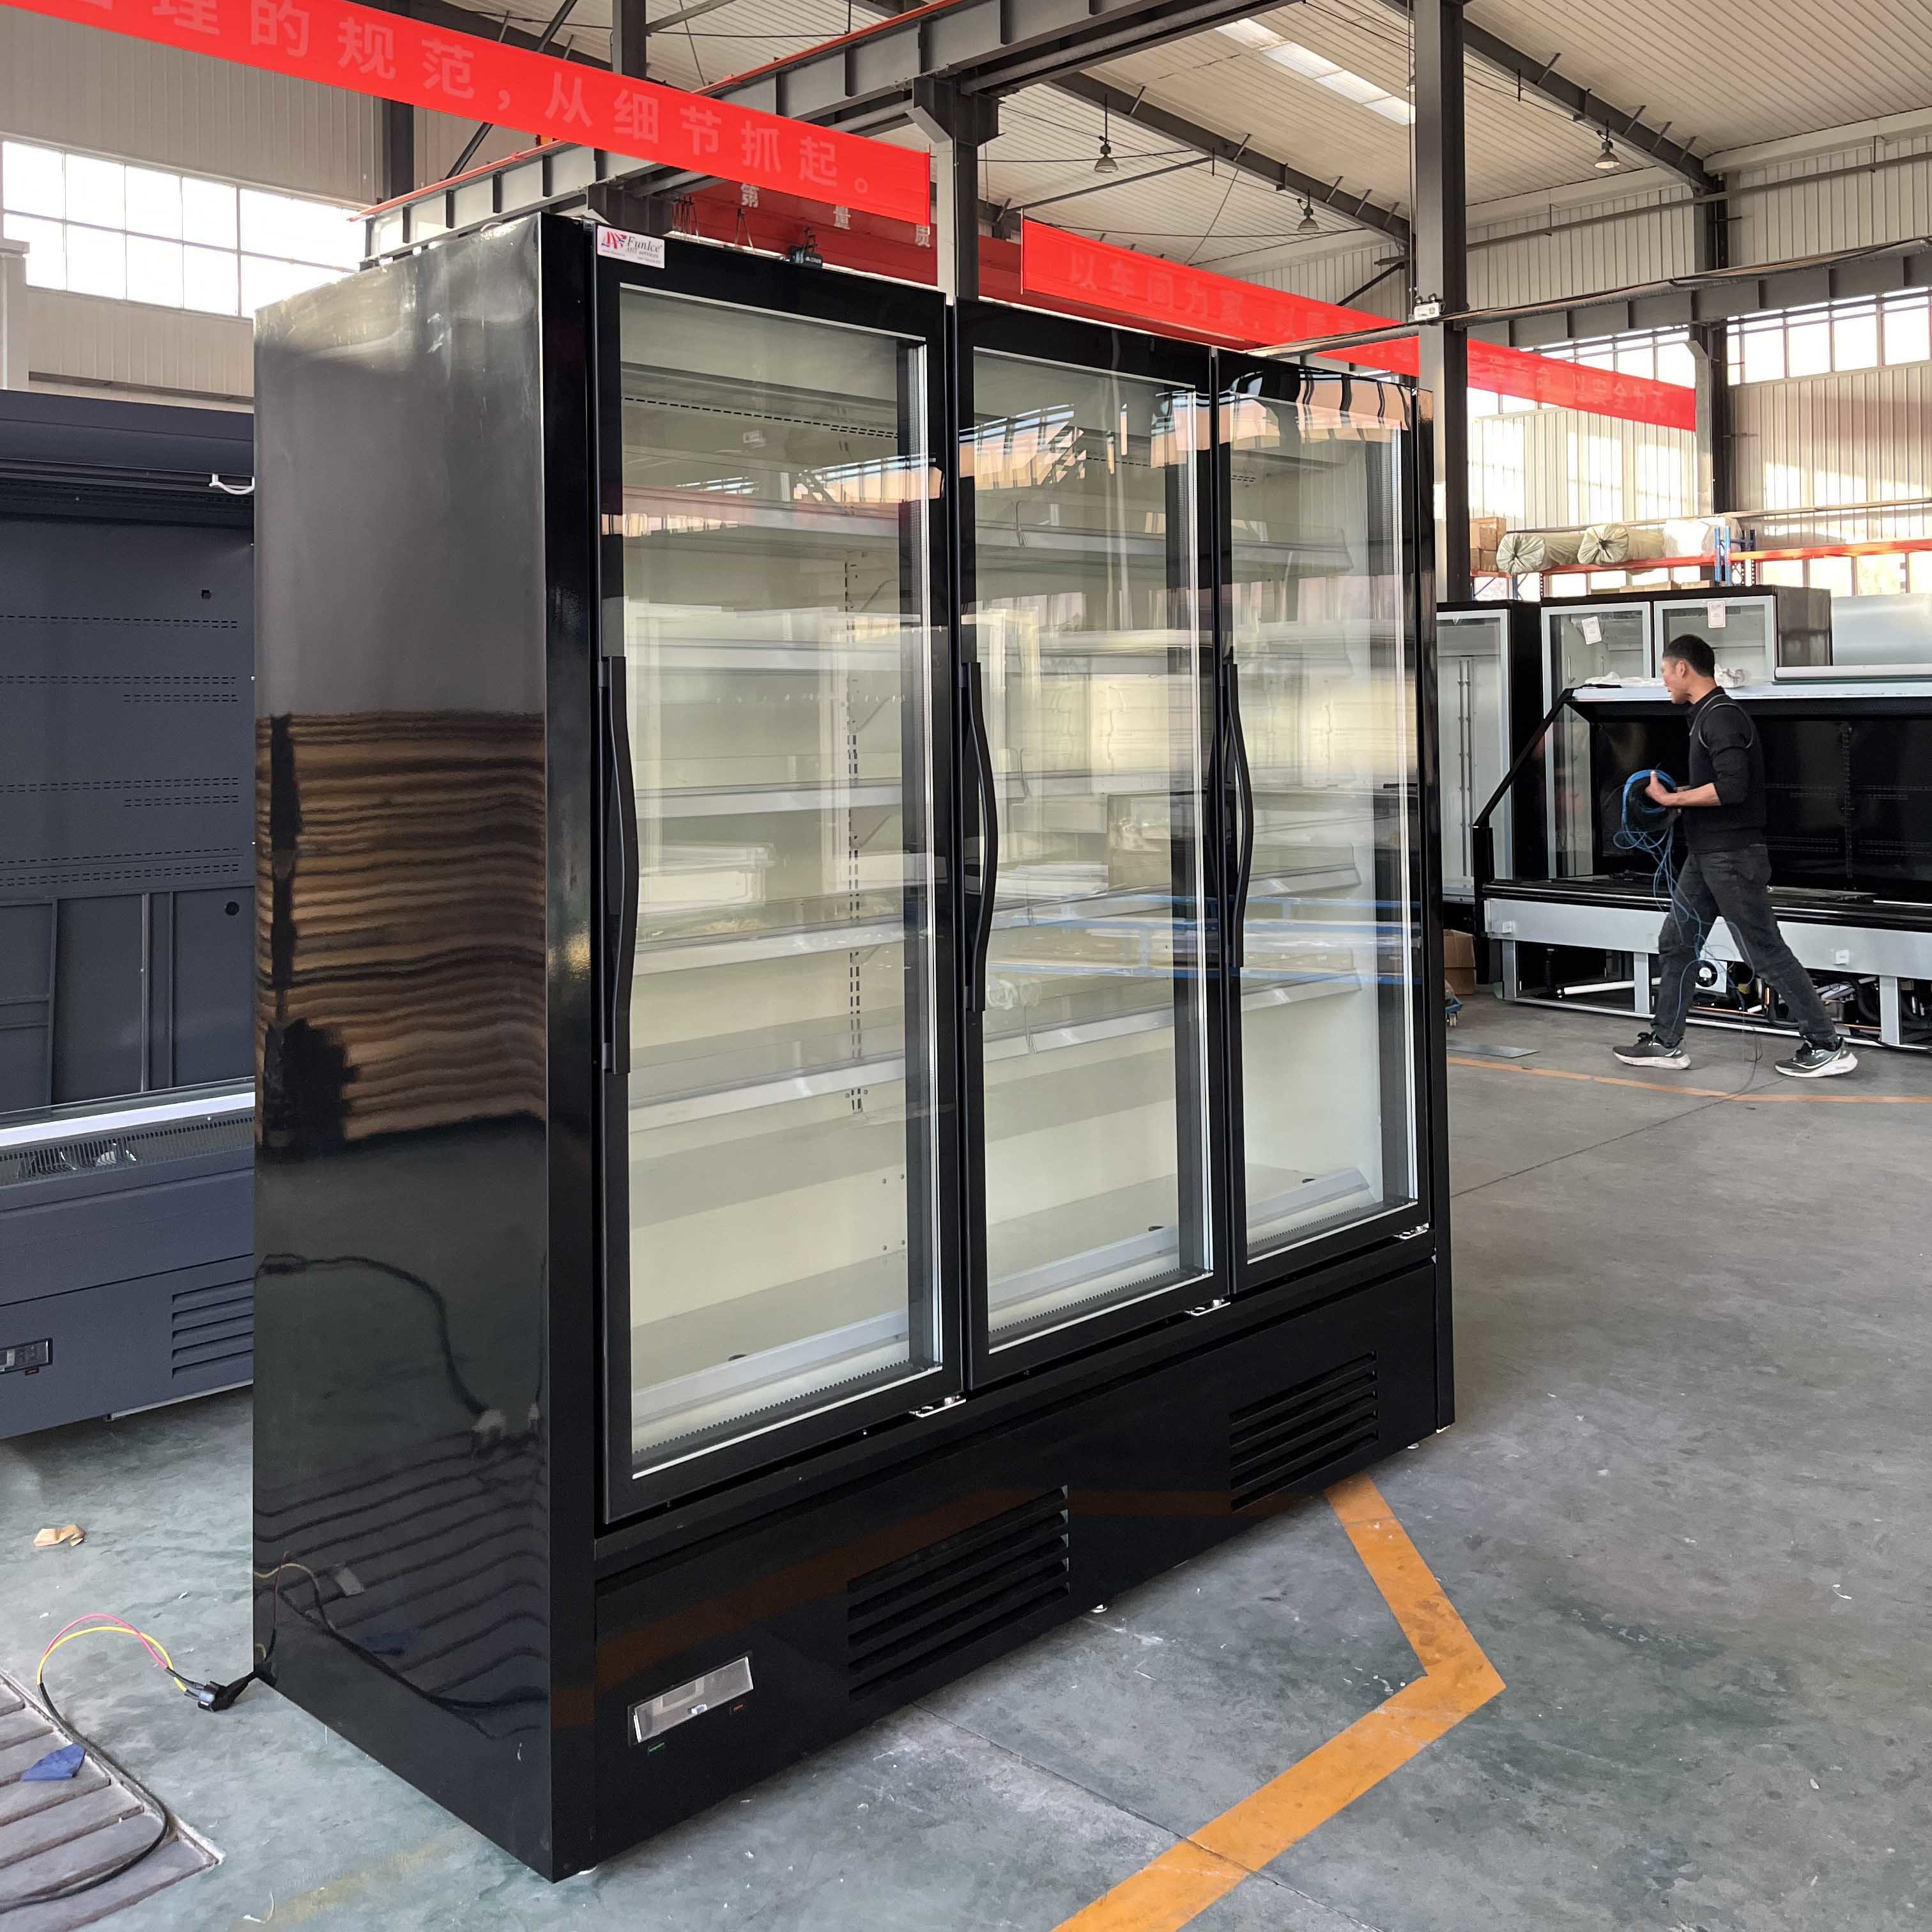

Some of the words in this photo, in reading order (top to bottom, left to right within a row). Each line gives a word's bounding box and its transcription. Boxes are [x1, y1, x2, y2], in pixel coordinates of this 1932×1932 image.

[82, 0, 868, 194] 理的规范，从细节抓起。
